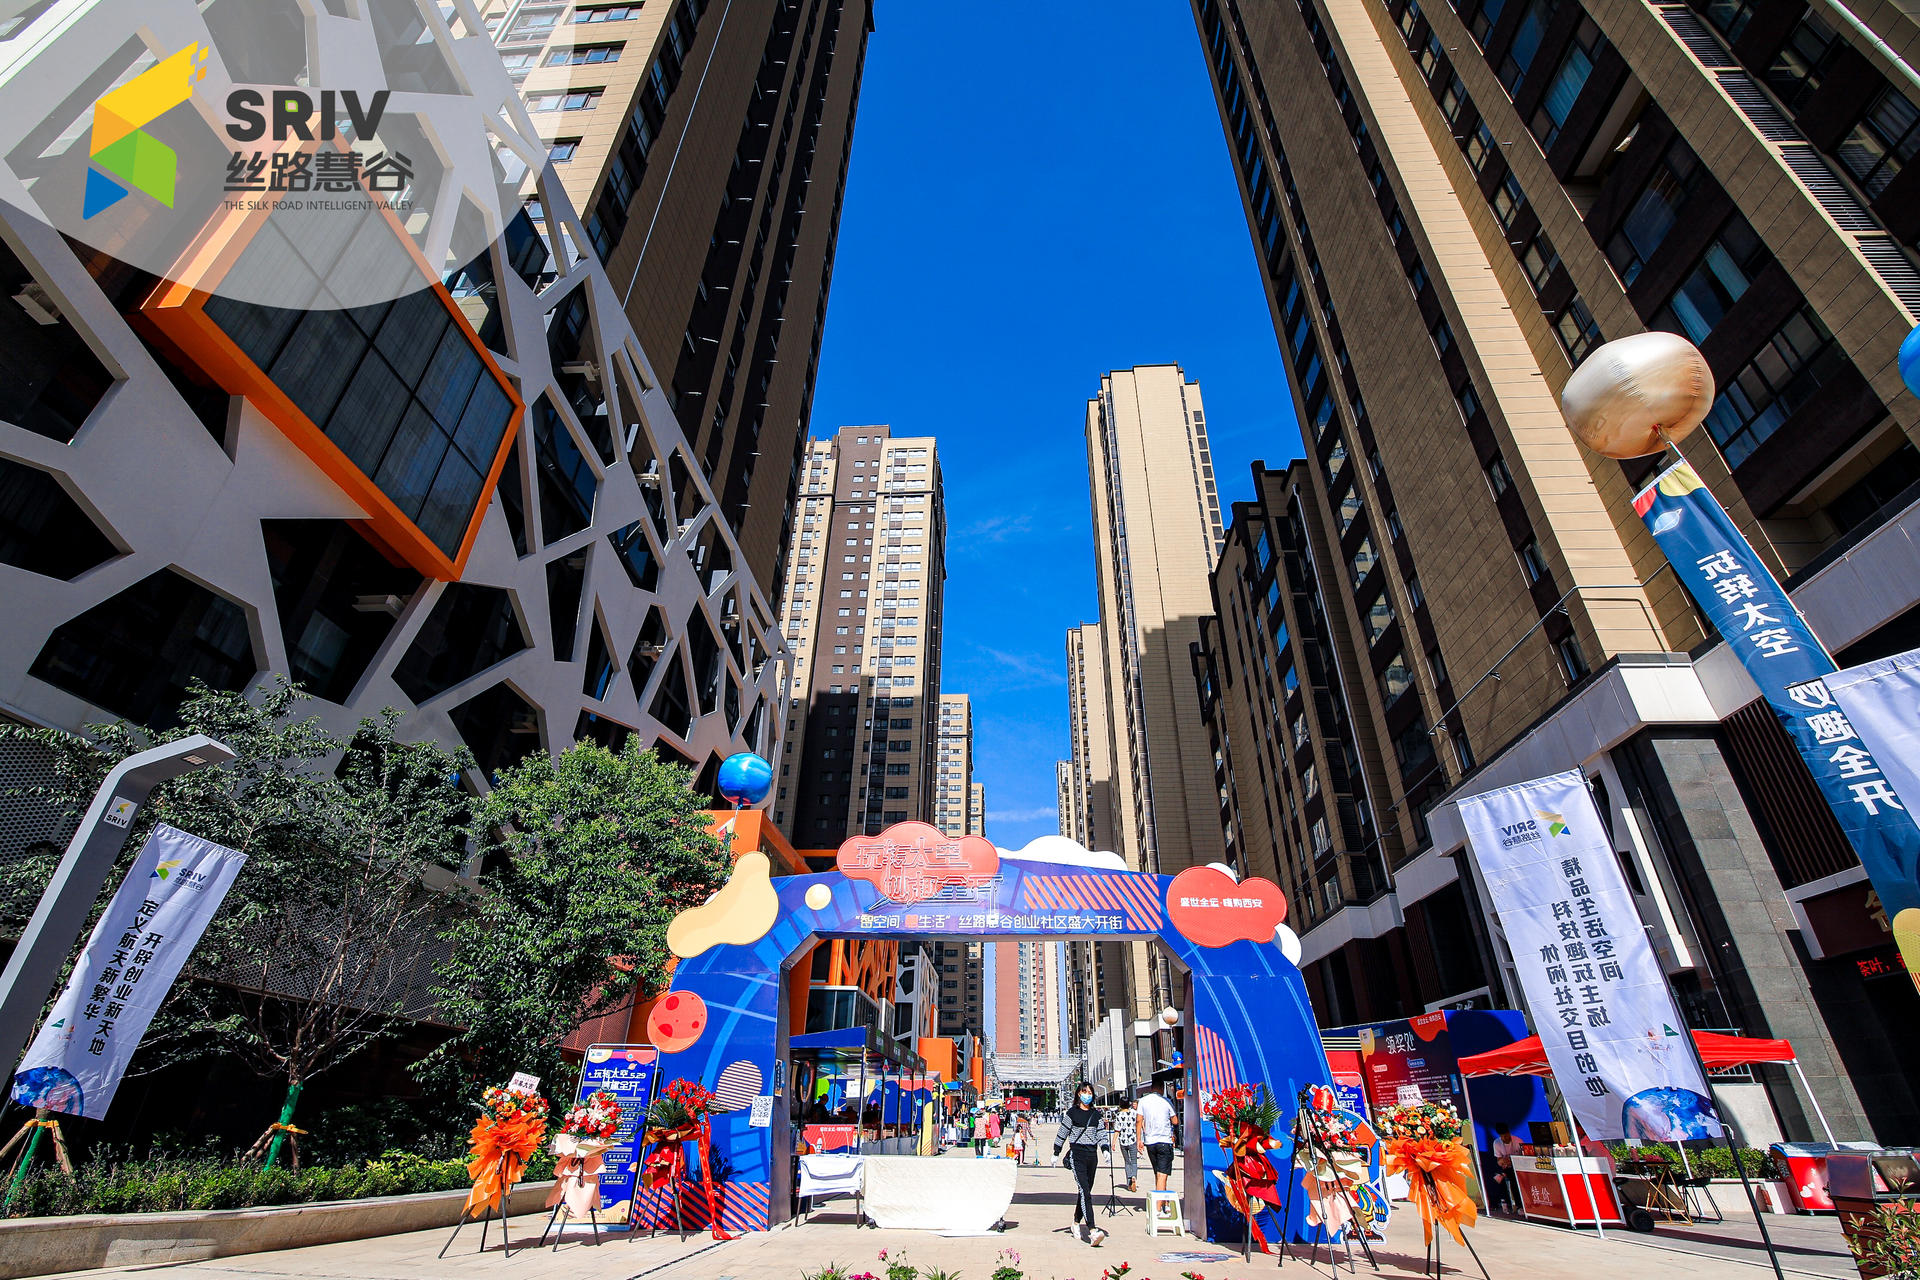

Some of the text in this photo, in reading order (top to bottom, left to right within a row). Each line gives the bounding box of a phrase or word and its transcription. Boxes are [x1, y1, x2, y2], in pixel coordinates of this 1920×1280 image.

[106, 814, 128, 827] SRIV
[178, 867, 208, 882] SRIV
[83, 899, 160, 1022] 定义航天新繁华
[88, 931, 163, 1057] 开辟创业新天地
[1385, 1031, 1417, 1055] 领奖处
